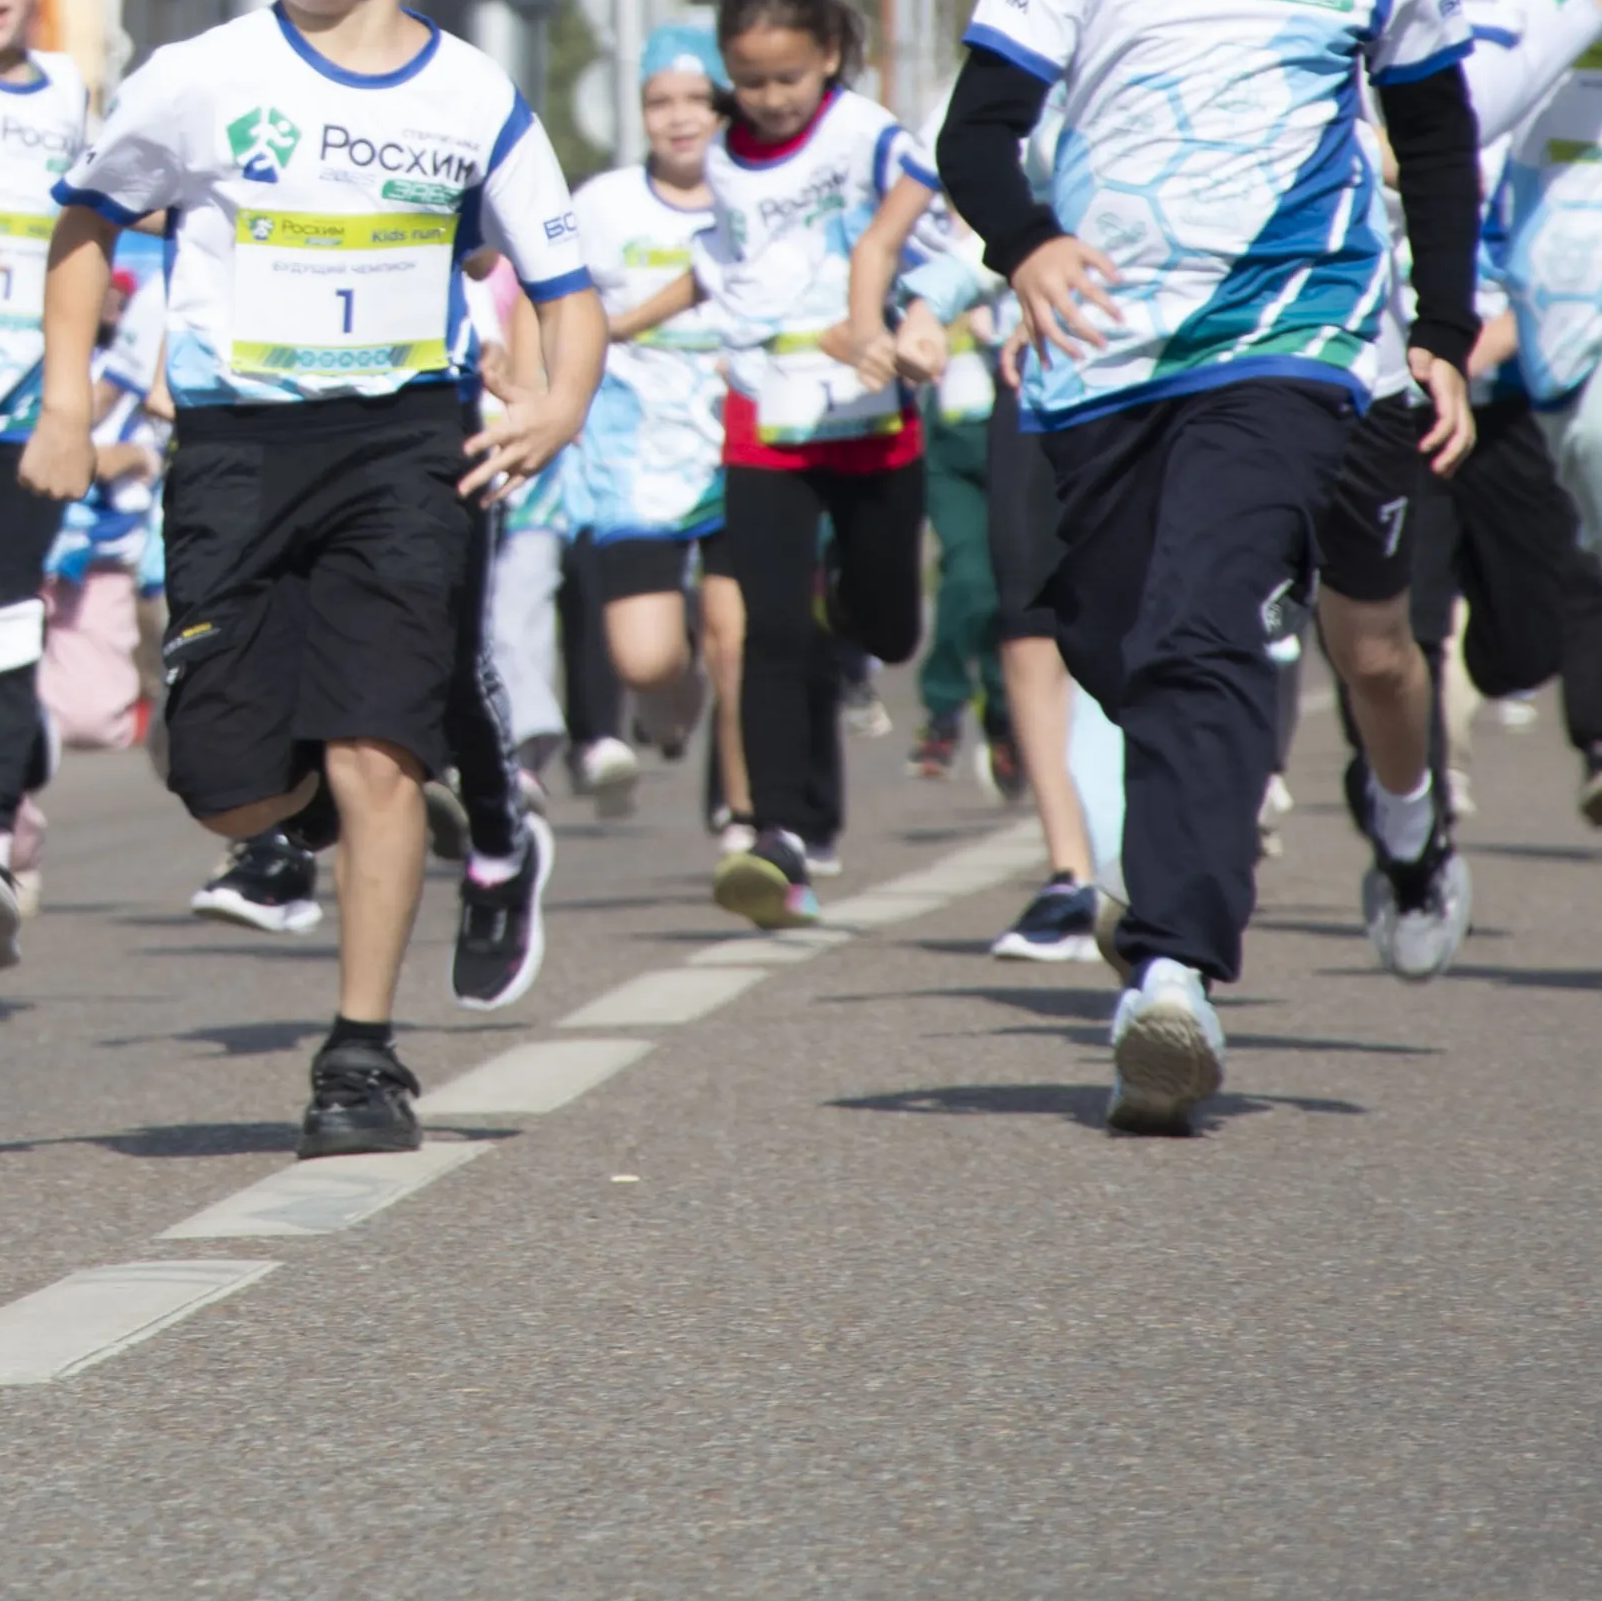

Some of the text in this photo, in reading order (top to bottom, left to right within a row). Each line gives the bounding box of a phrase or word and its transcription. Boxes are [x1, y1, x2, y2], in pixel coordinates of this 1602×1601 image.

[372, 229, 442, 244] Kids run
[336, 288, 354, 334] 1
[1380, 496, 1409, 558] 7
